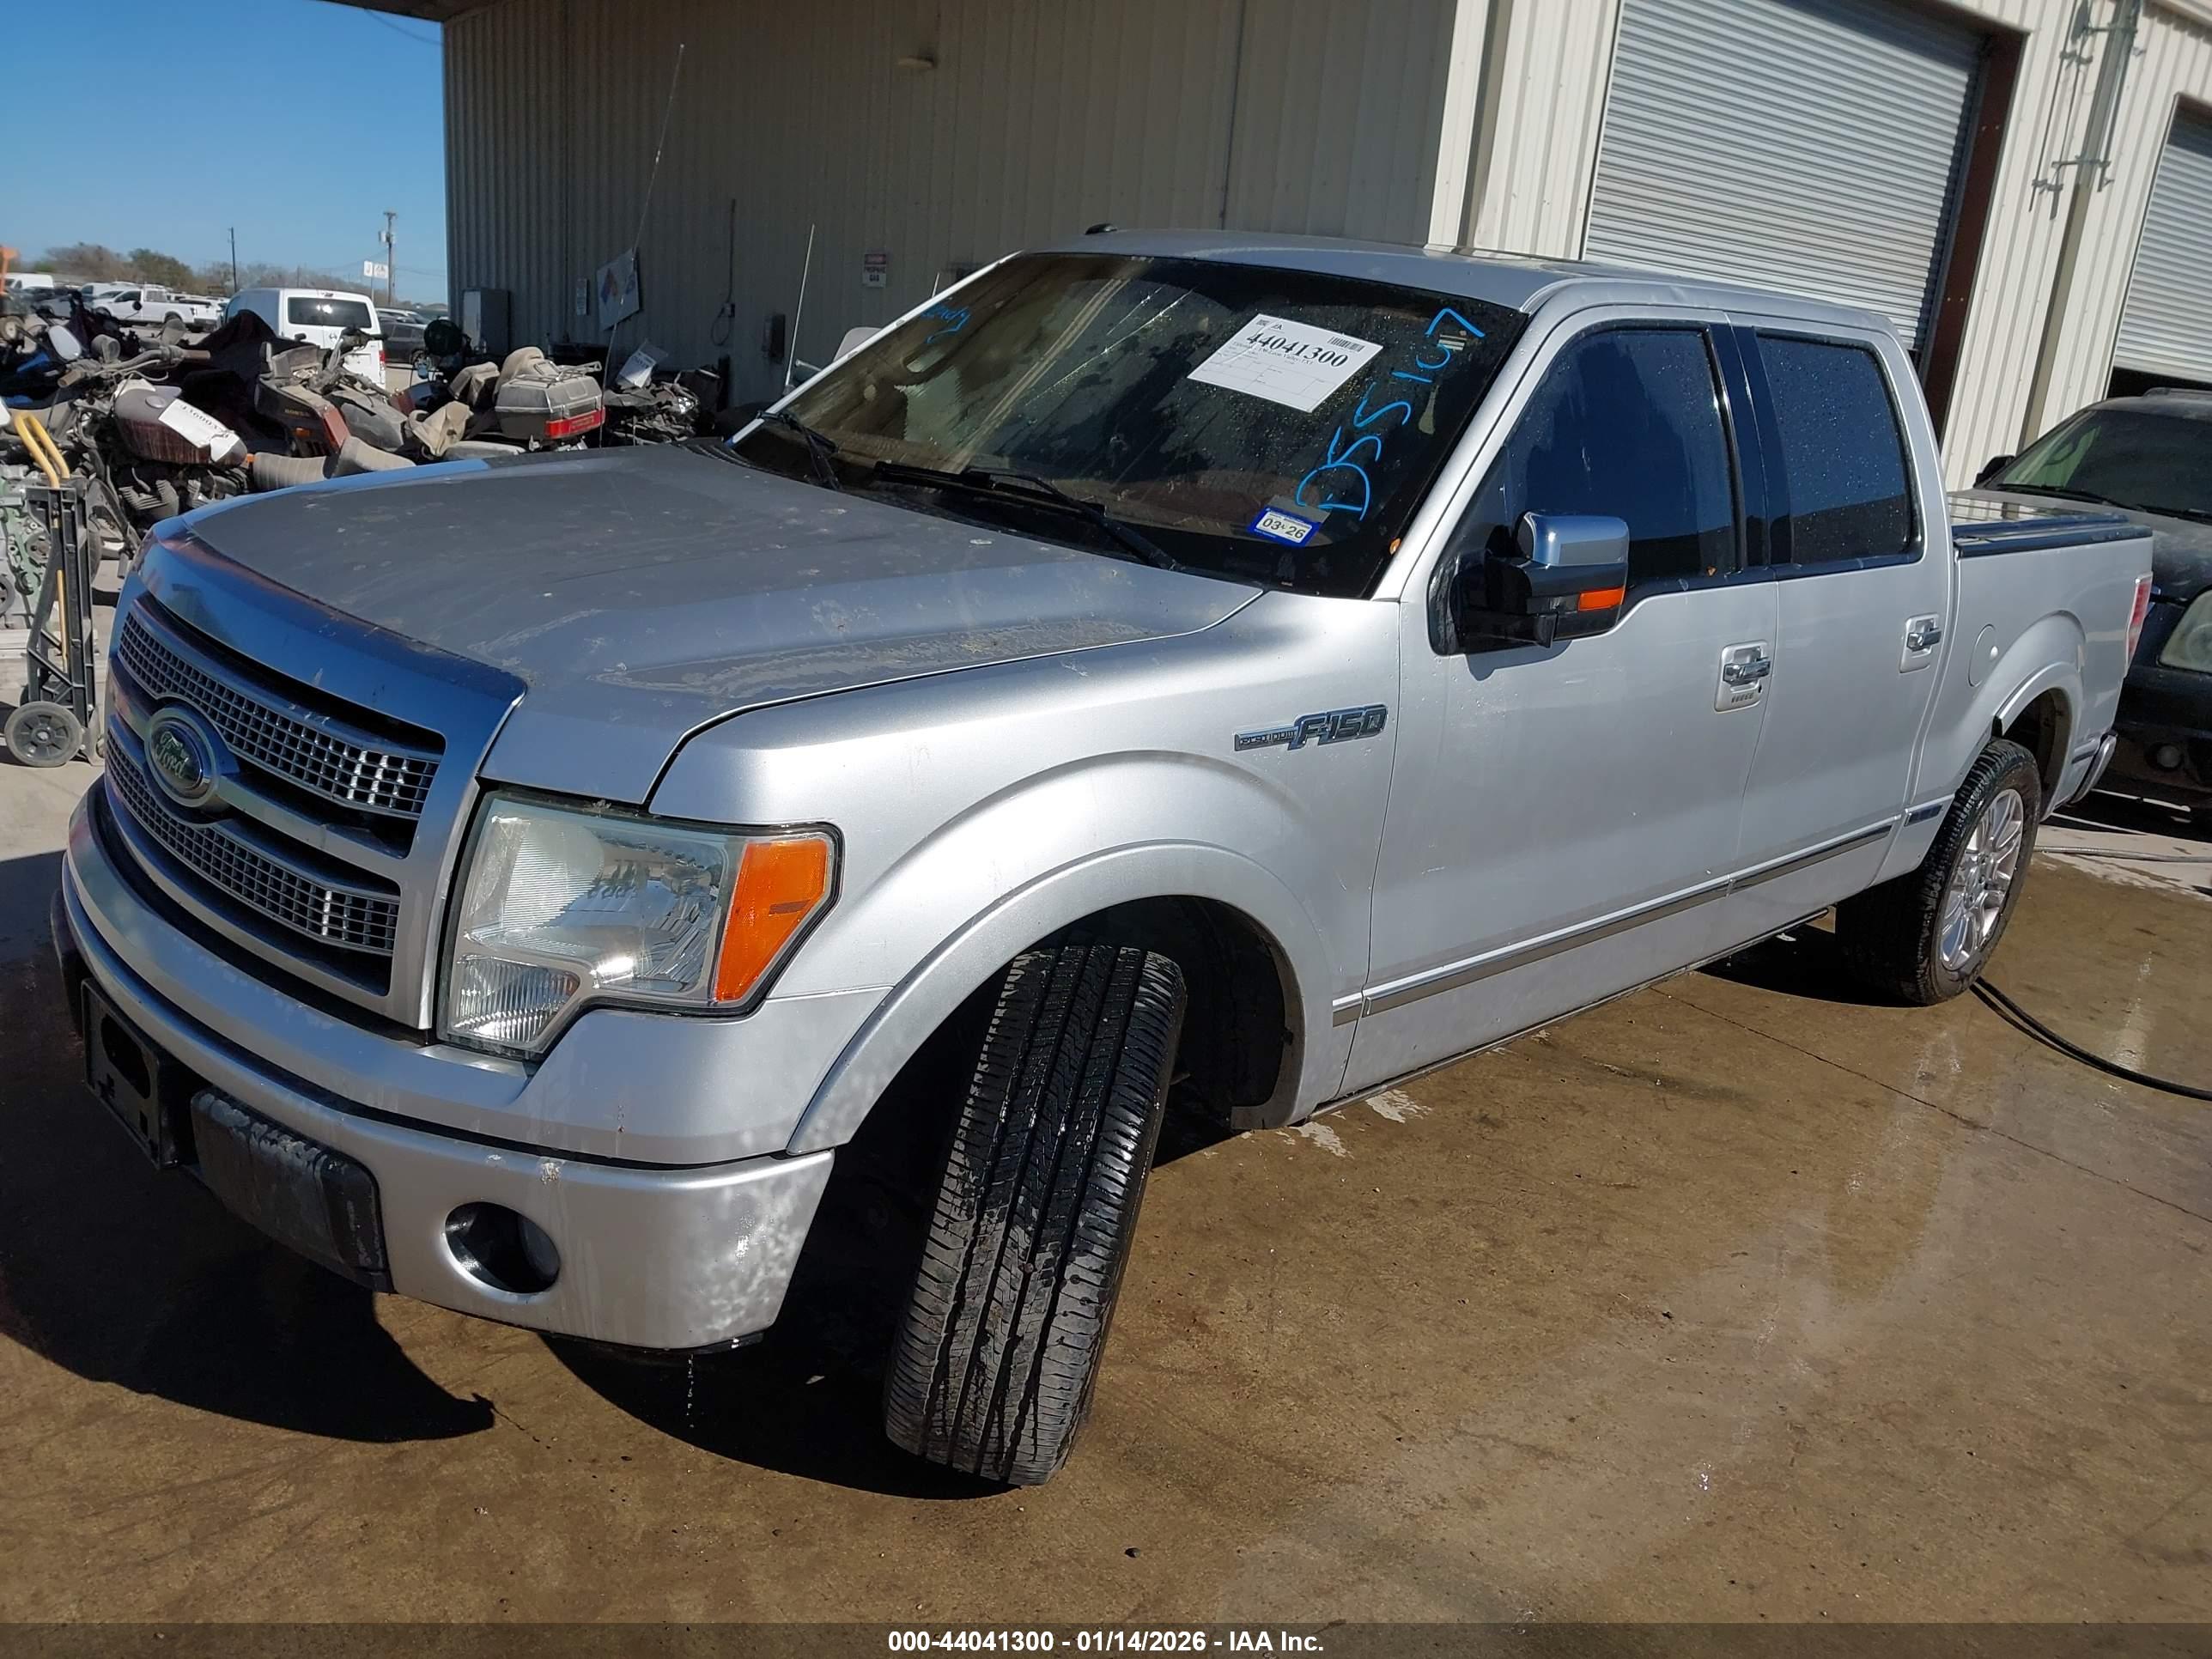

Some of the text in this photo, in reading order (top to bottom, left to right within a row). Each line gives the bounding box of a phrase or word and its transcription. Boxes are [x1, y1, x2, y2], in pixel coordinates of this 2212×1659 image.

[1246, 332, 1349, 368] 44041300
[1262, 518, 1280, 531] 03
[1285, 526, 1306, 539] 26
[156, 732, 189, 780] Ford
